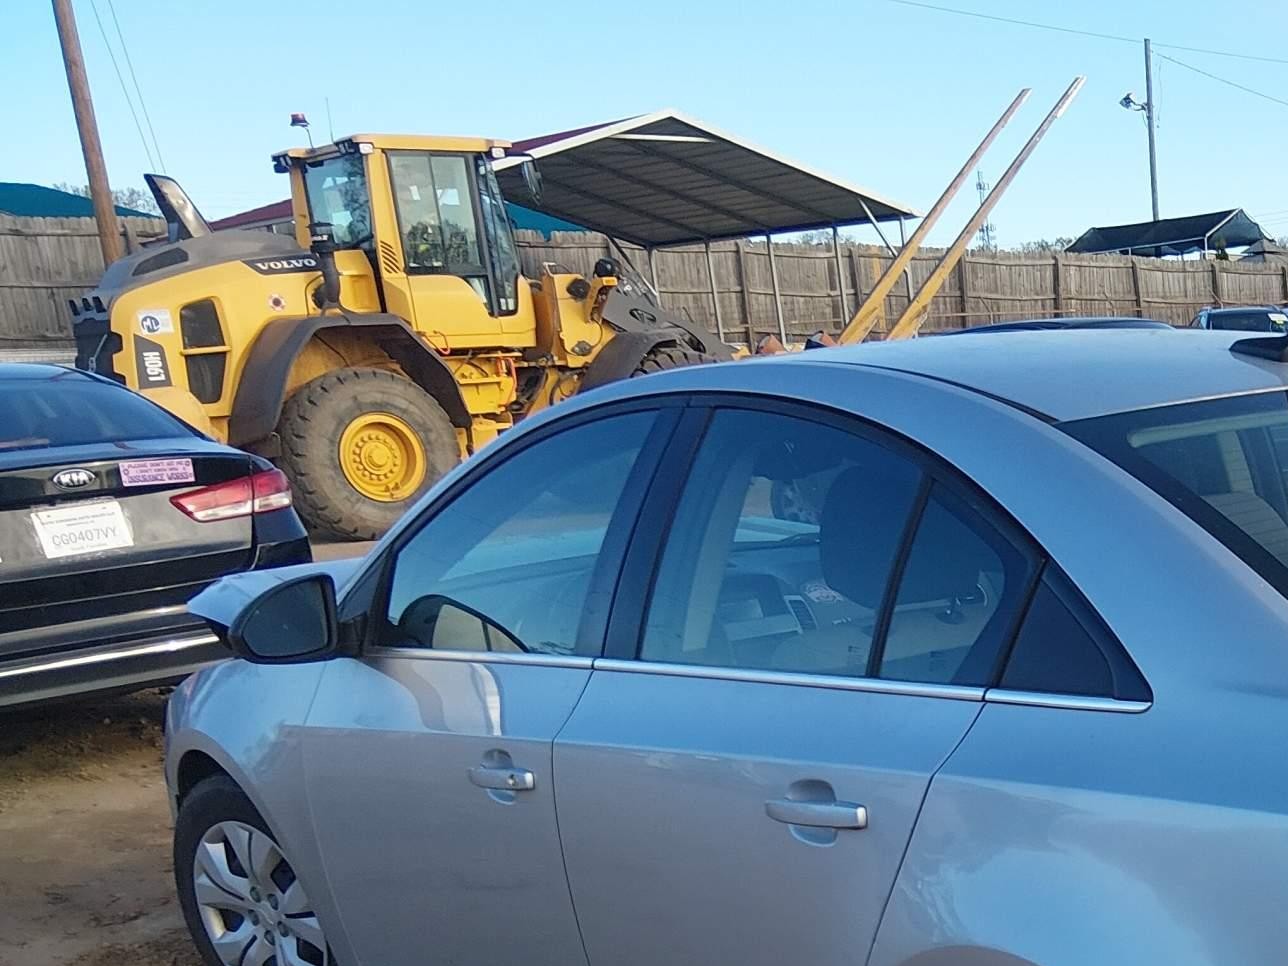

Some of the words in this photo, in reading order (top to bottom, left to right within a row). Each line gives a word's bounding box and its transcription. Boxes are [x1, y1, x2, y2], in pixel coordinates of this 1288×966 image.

[255, 258, 317, 270] VOLVO
[143, 351, 166, 381] L90H
[60, 472, 89, 486] KIA
